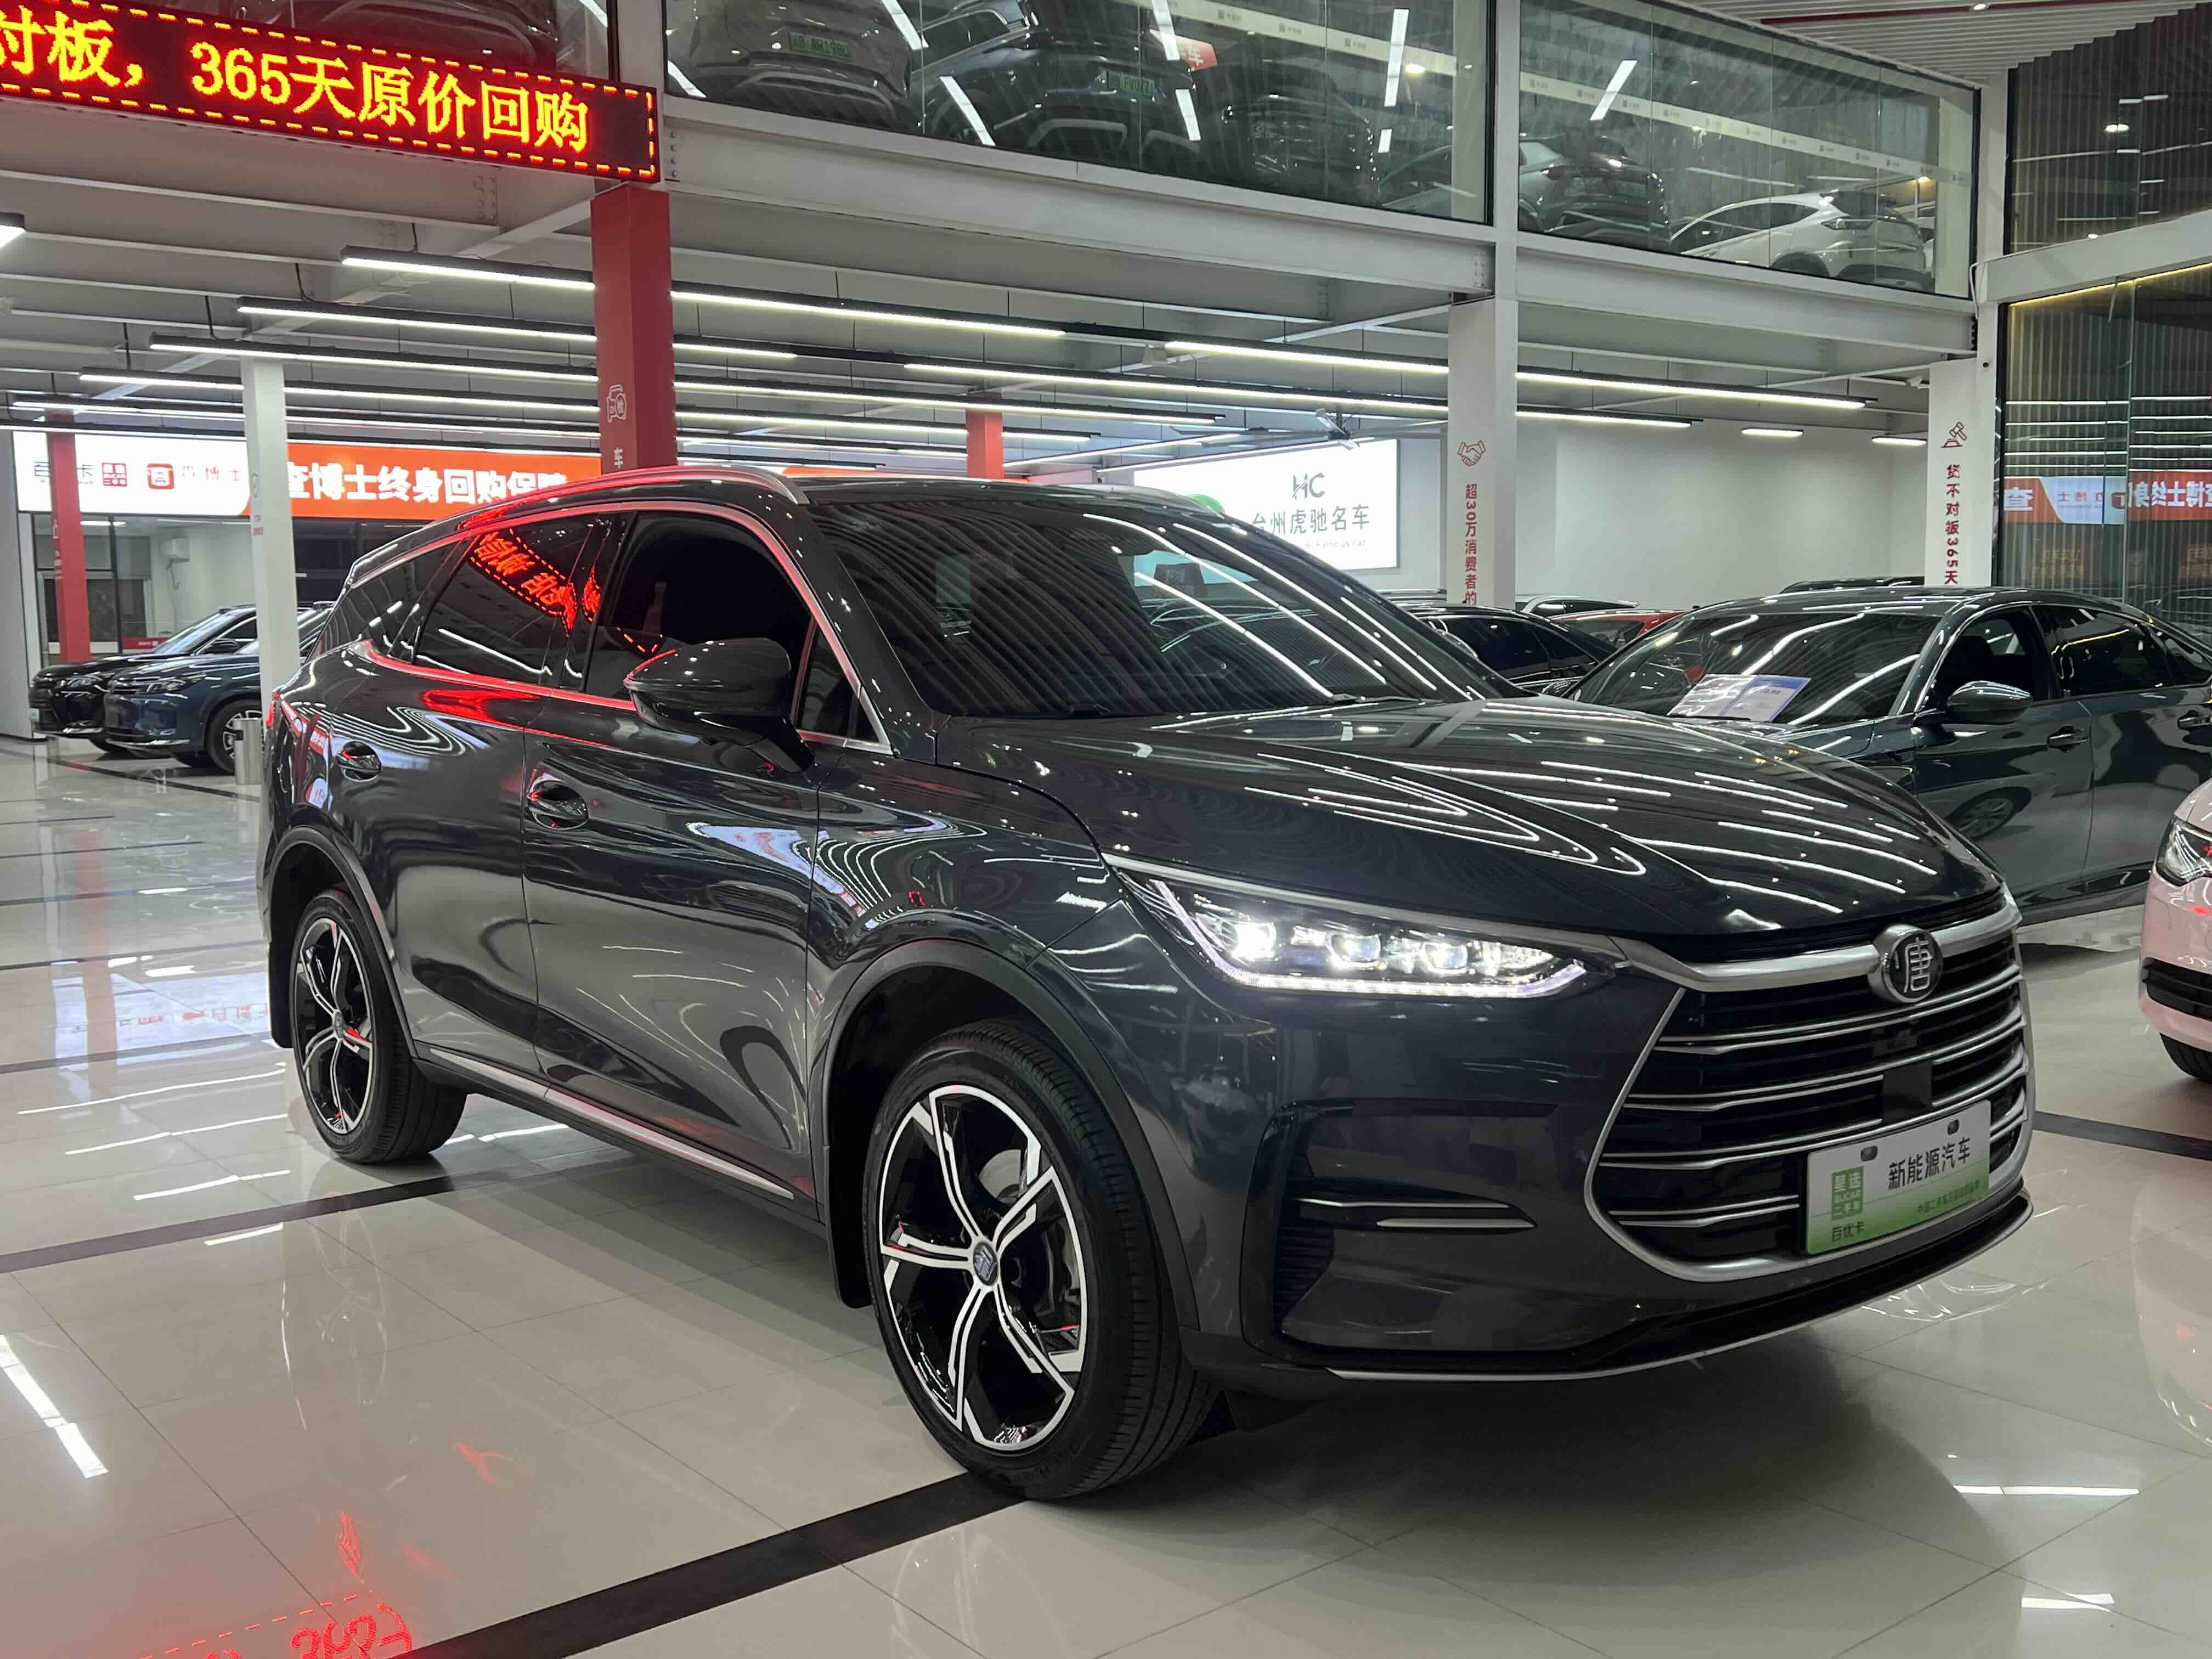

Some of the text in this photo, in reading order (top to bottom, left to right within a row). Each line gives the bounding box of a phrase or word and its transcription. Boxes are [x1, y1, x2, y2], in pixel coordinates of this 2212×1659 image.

[614, 447, 624, 469] 车
[1292, 472, 1325, 500] HC
[1252, 503, 1370, 535] 台州虎驰名车
[1888, 1136, 1971, 1190] 新能源汽车
